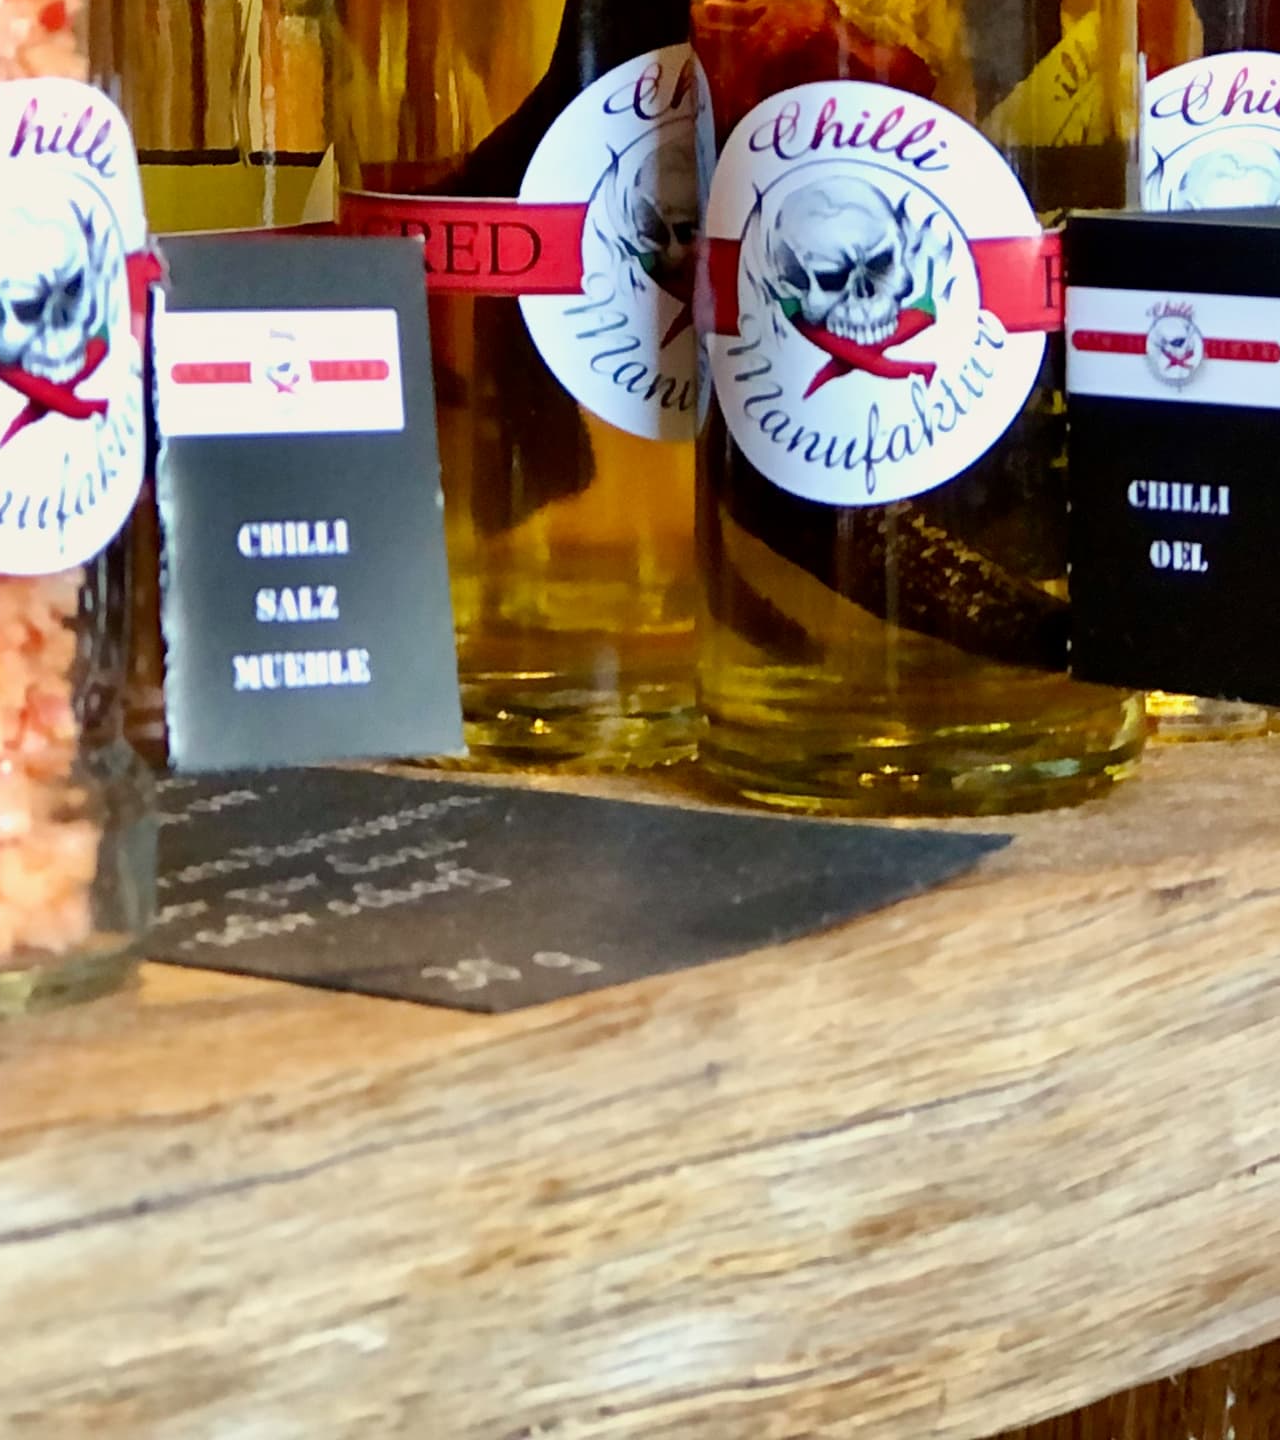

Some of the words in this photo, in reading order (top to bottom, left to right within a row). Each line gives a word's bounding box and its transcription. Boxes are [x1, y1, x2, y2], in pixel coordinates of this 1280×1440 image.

[749, 97, 950, 173] Chilli
[727, 313, 1006, 495] Manufaktur
[1127, 480, 1230, 515] CHILLI
[238, 518, 349, 557] CHILLI
[1149, 540, 1208, 572] OEL
[255, 585, 340, 622] SALZ
[232, 648, 372, 691] MUEHLE
